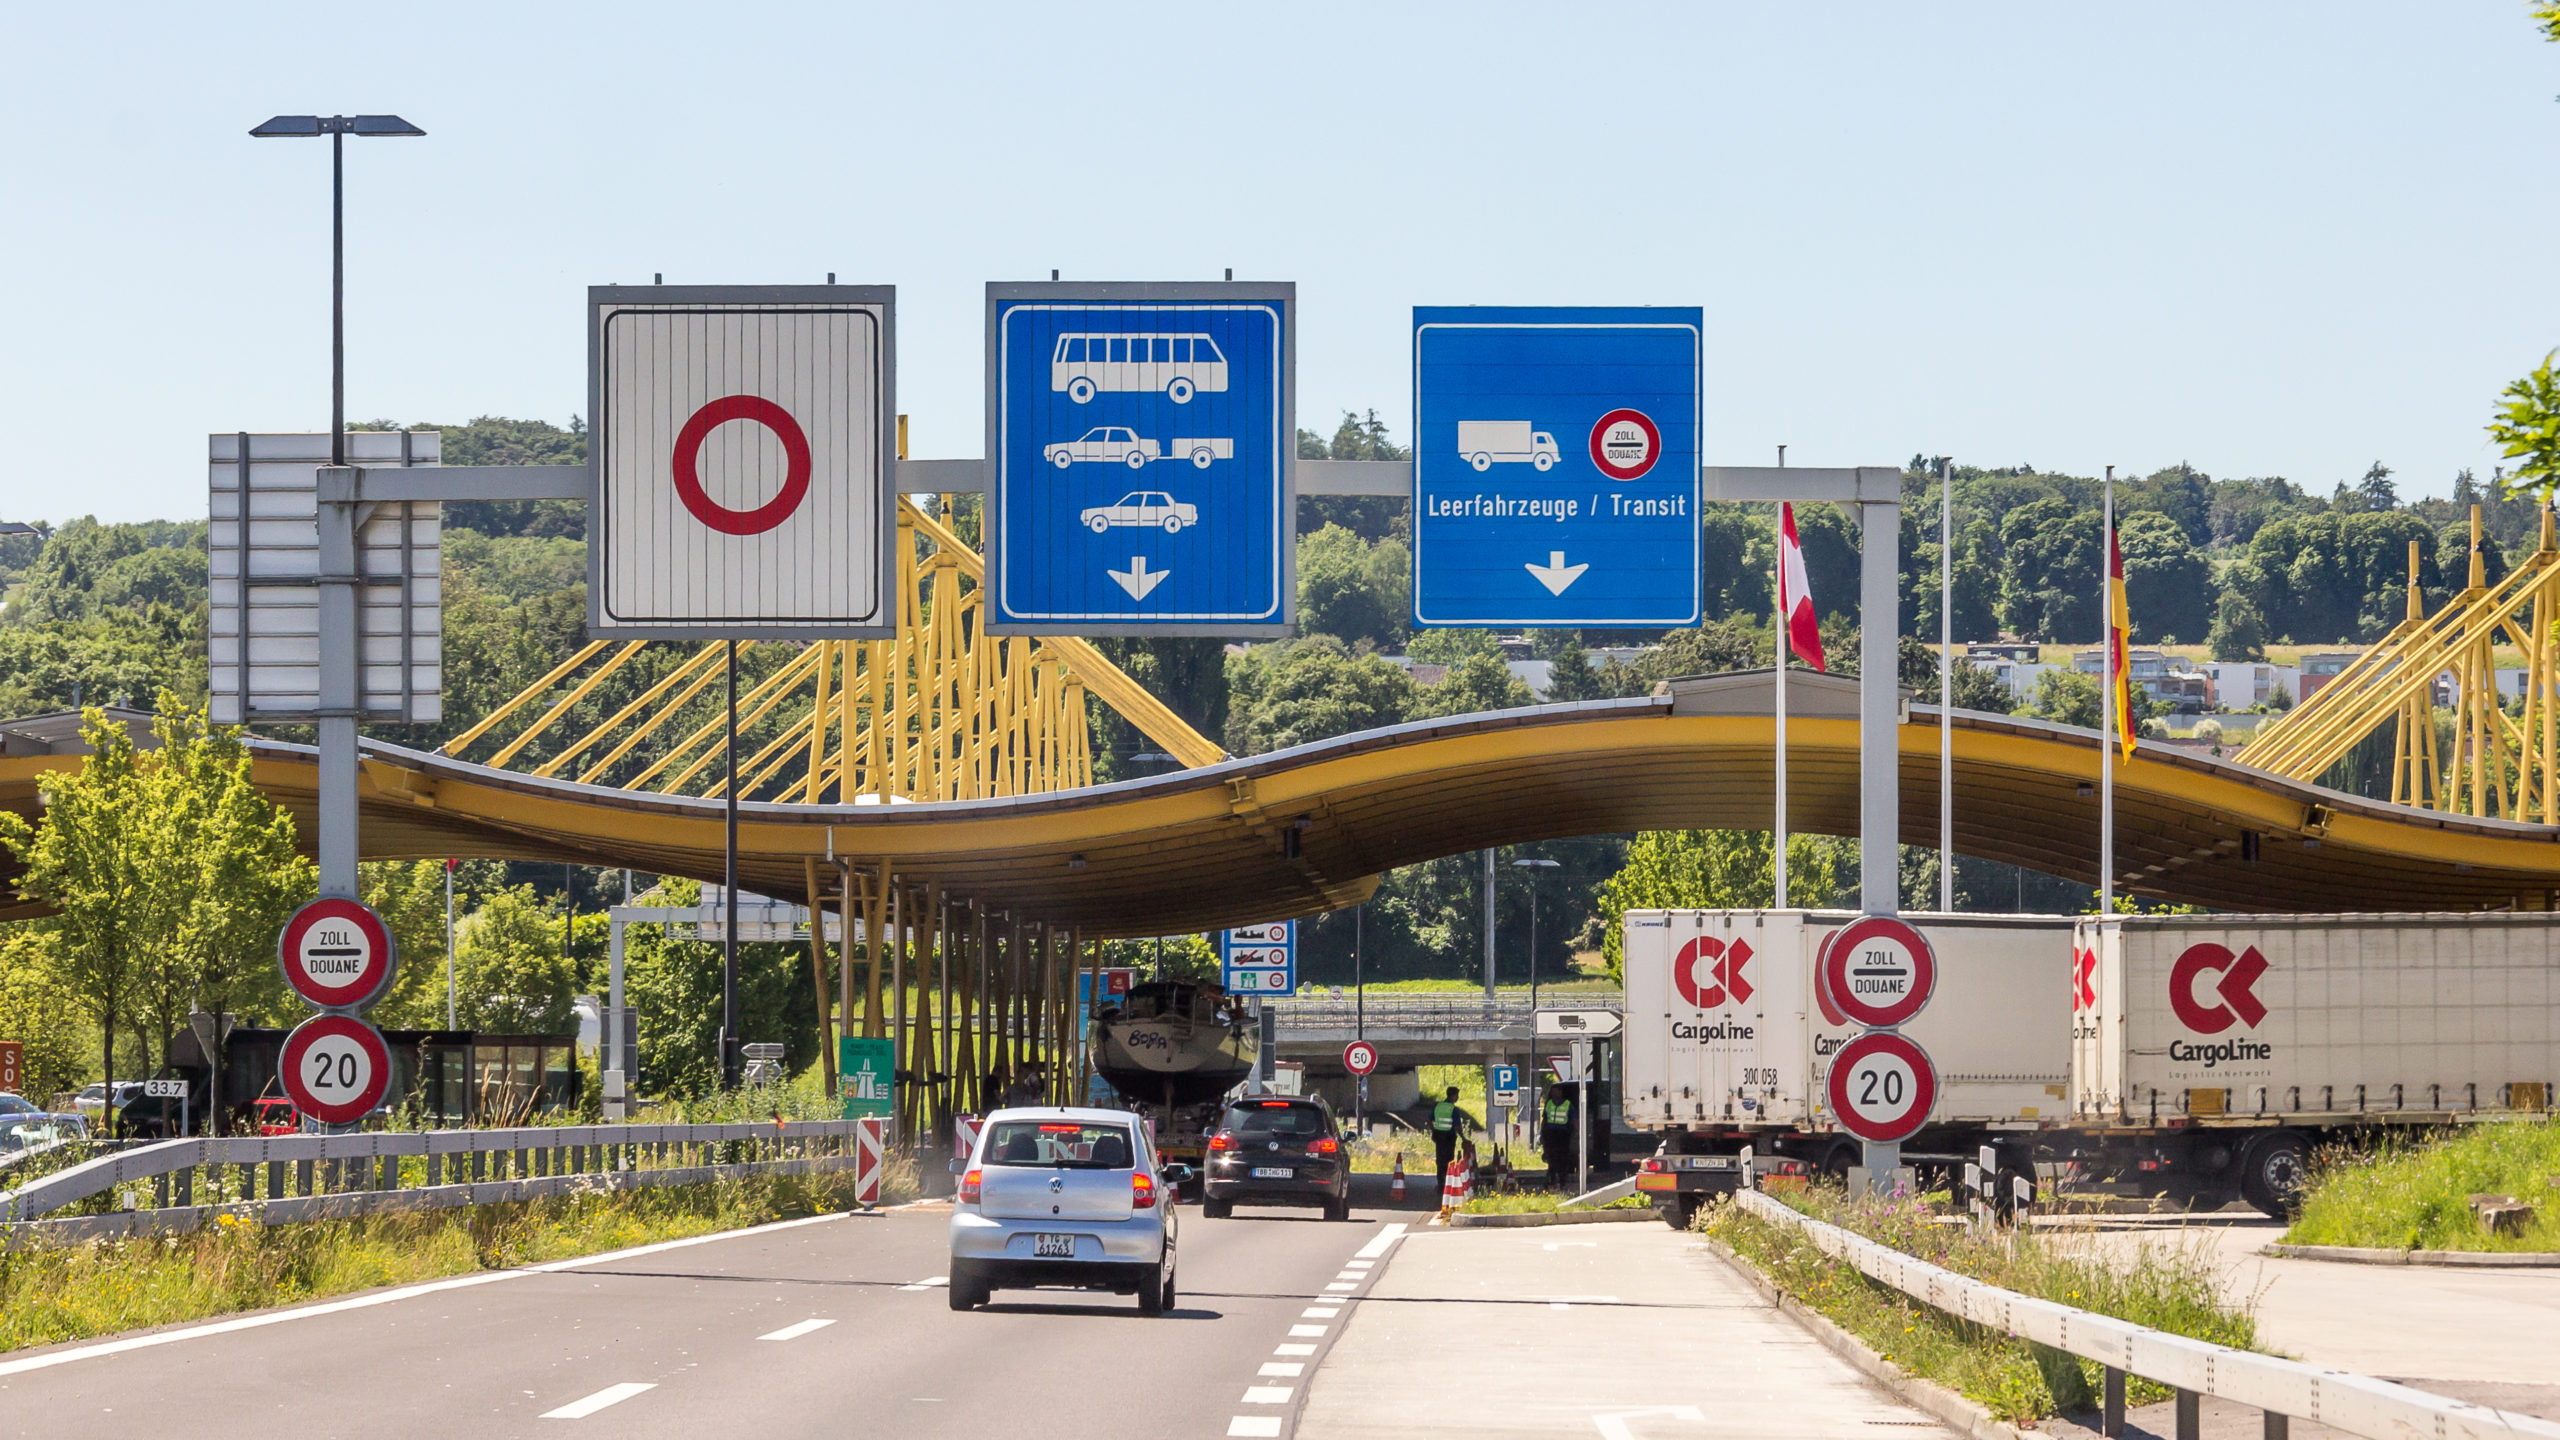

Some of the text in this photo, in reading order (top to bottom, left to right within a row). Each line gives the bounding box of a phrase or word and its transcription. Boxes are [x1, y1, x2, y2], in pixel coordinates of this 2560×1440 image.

[1615, 431, 1636, 440] ZOLL
[1428, 494, 1686, 522] Leerfahrzeuge / Transit
[320, 931, 351, 946] ZOLL
[1865, 951, 1896, 966] ZOLL
[311, 959, 360, 974] DOUANE
[1855, 979, 1905, 994] DOUANE
[1354, 1052, 1367, 1064] 50
[2169, 1037, 2271, 1068] CargoLine
[314, 1052, 358, 1088] 20
[1743, 1067, 1778, 1086] 300 058
[1499, 1069, 1512, 1089] P
[150, 1081, 183, 1096] 33.7
[1860, 1070, 1903, 1105] 20
[1039, 1243, 1070, 1256] 61263
